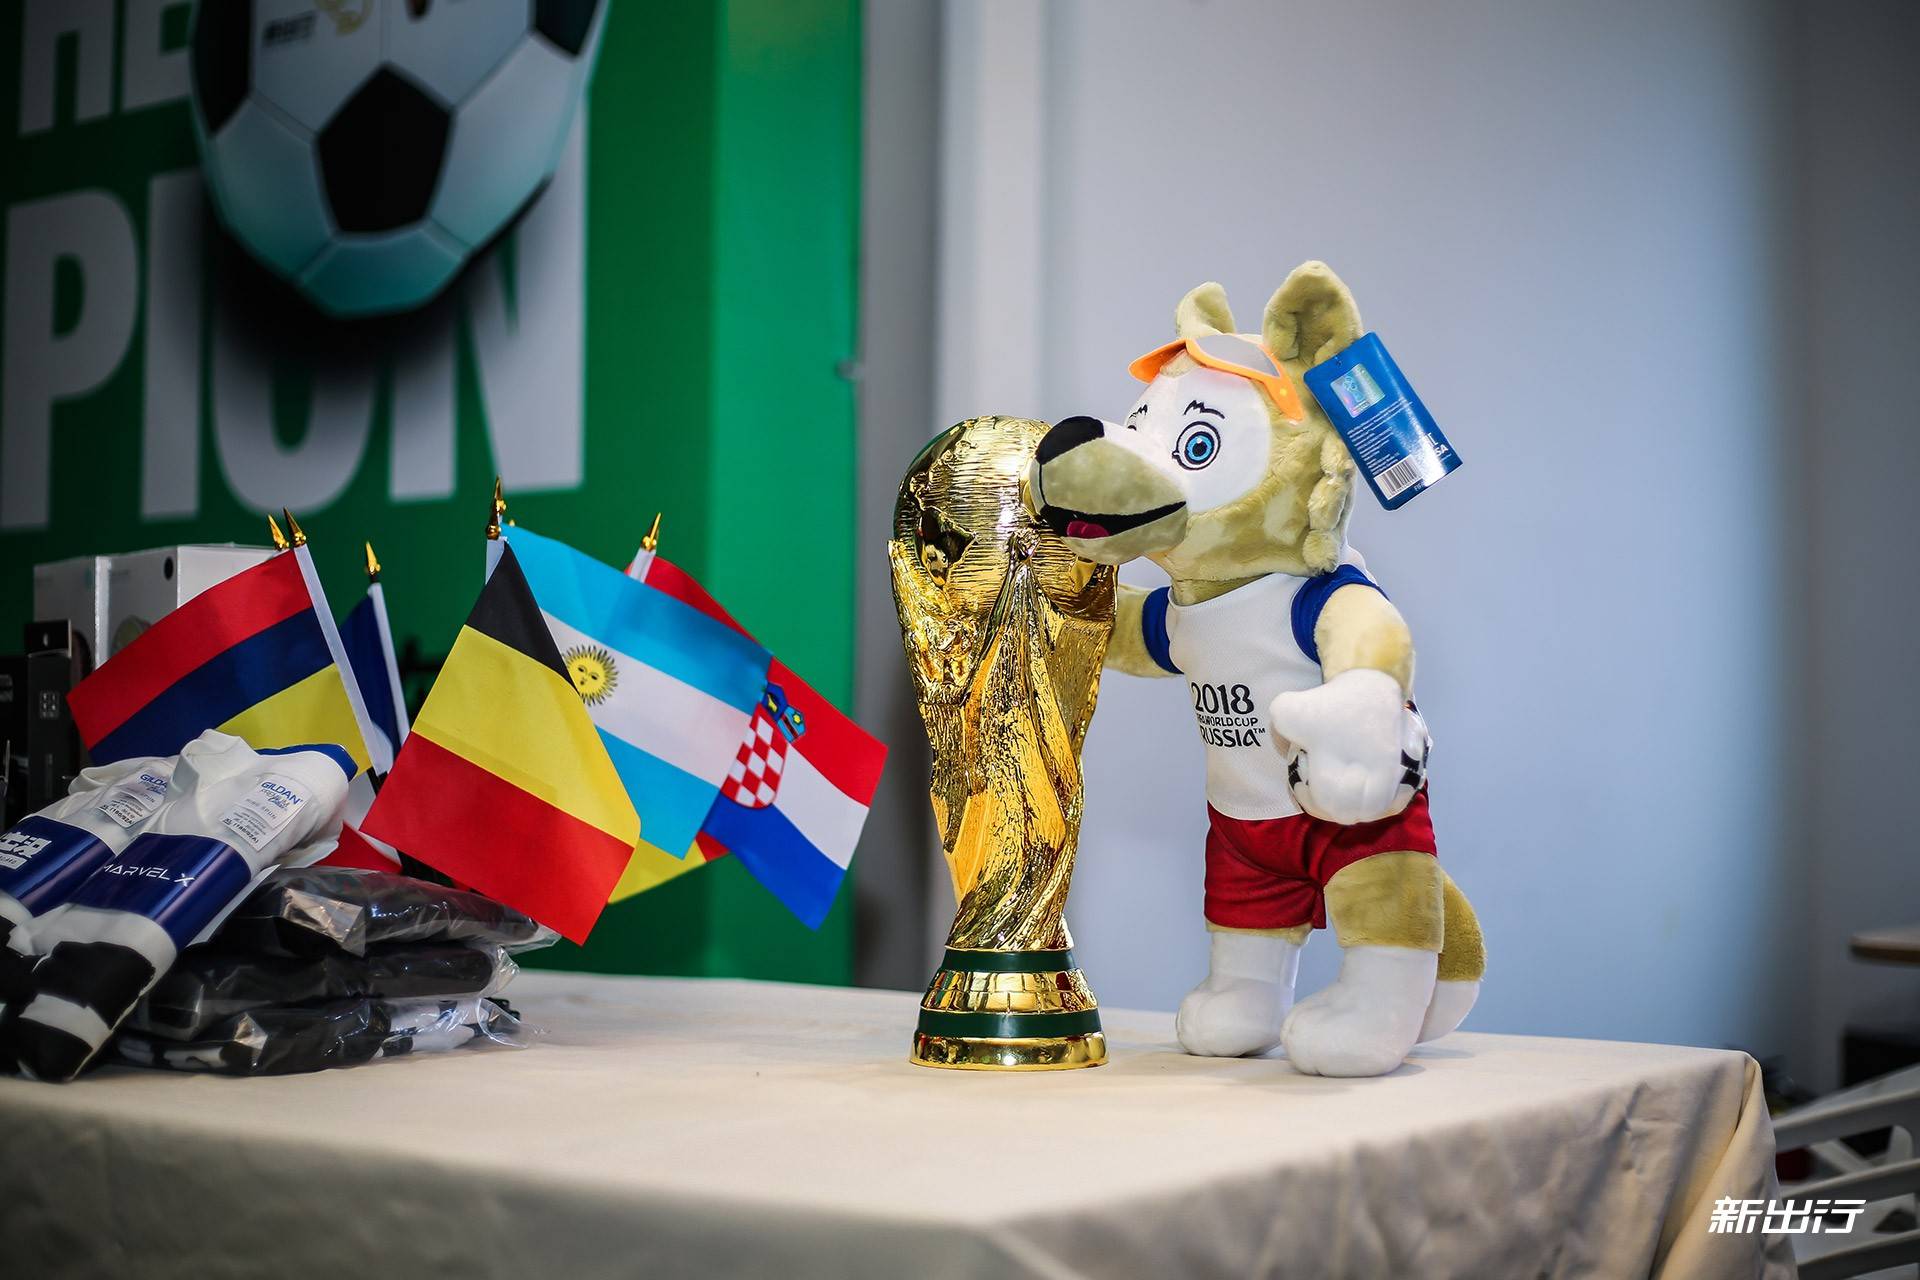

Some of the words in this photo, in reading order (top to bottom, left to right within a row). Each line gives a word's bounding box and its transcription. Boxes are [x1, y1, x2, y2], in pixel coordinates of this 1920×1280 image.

[1191, 682, 1255, 714] 2018
[1234, 717, 1258, 727] CUP
[140, 773, 168, 789] GILDA
[261, 781, 301, 805] GILDAN
[174, 872, 195, 888] X
